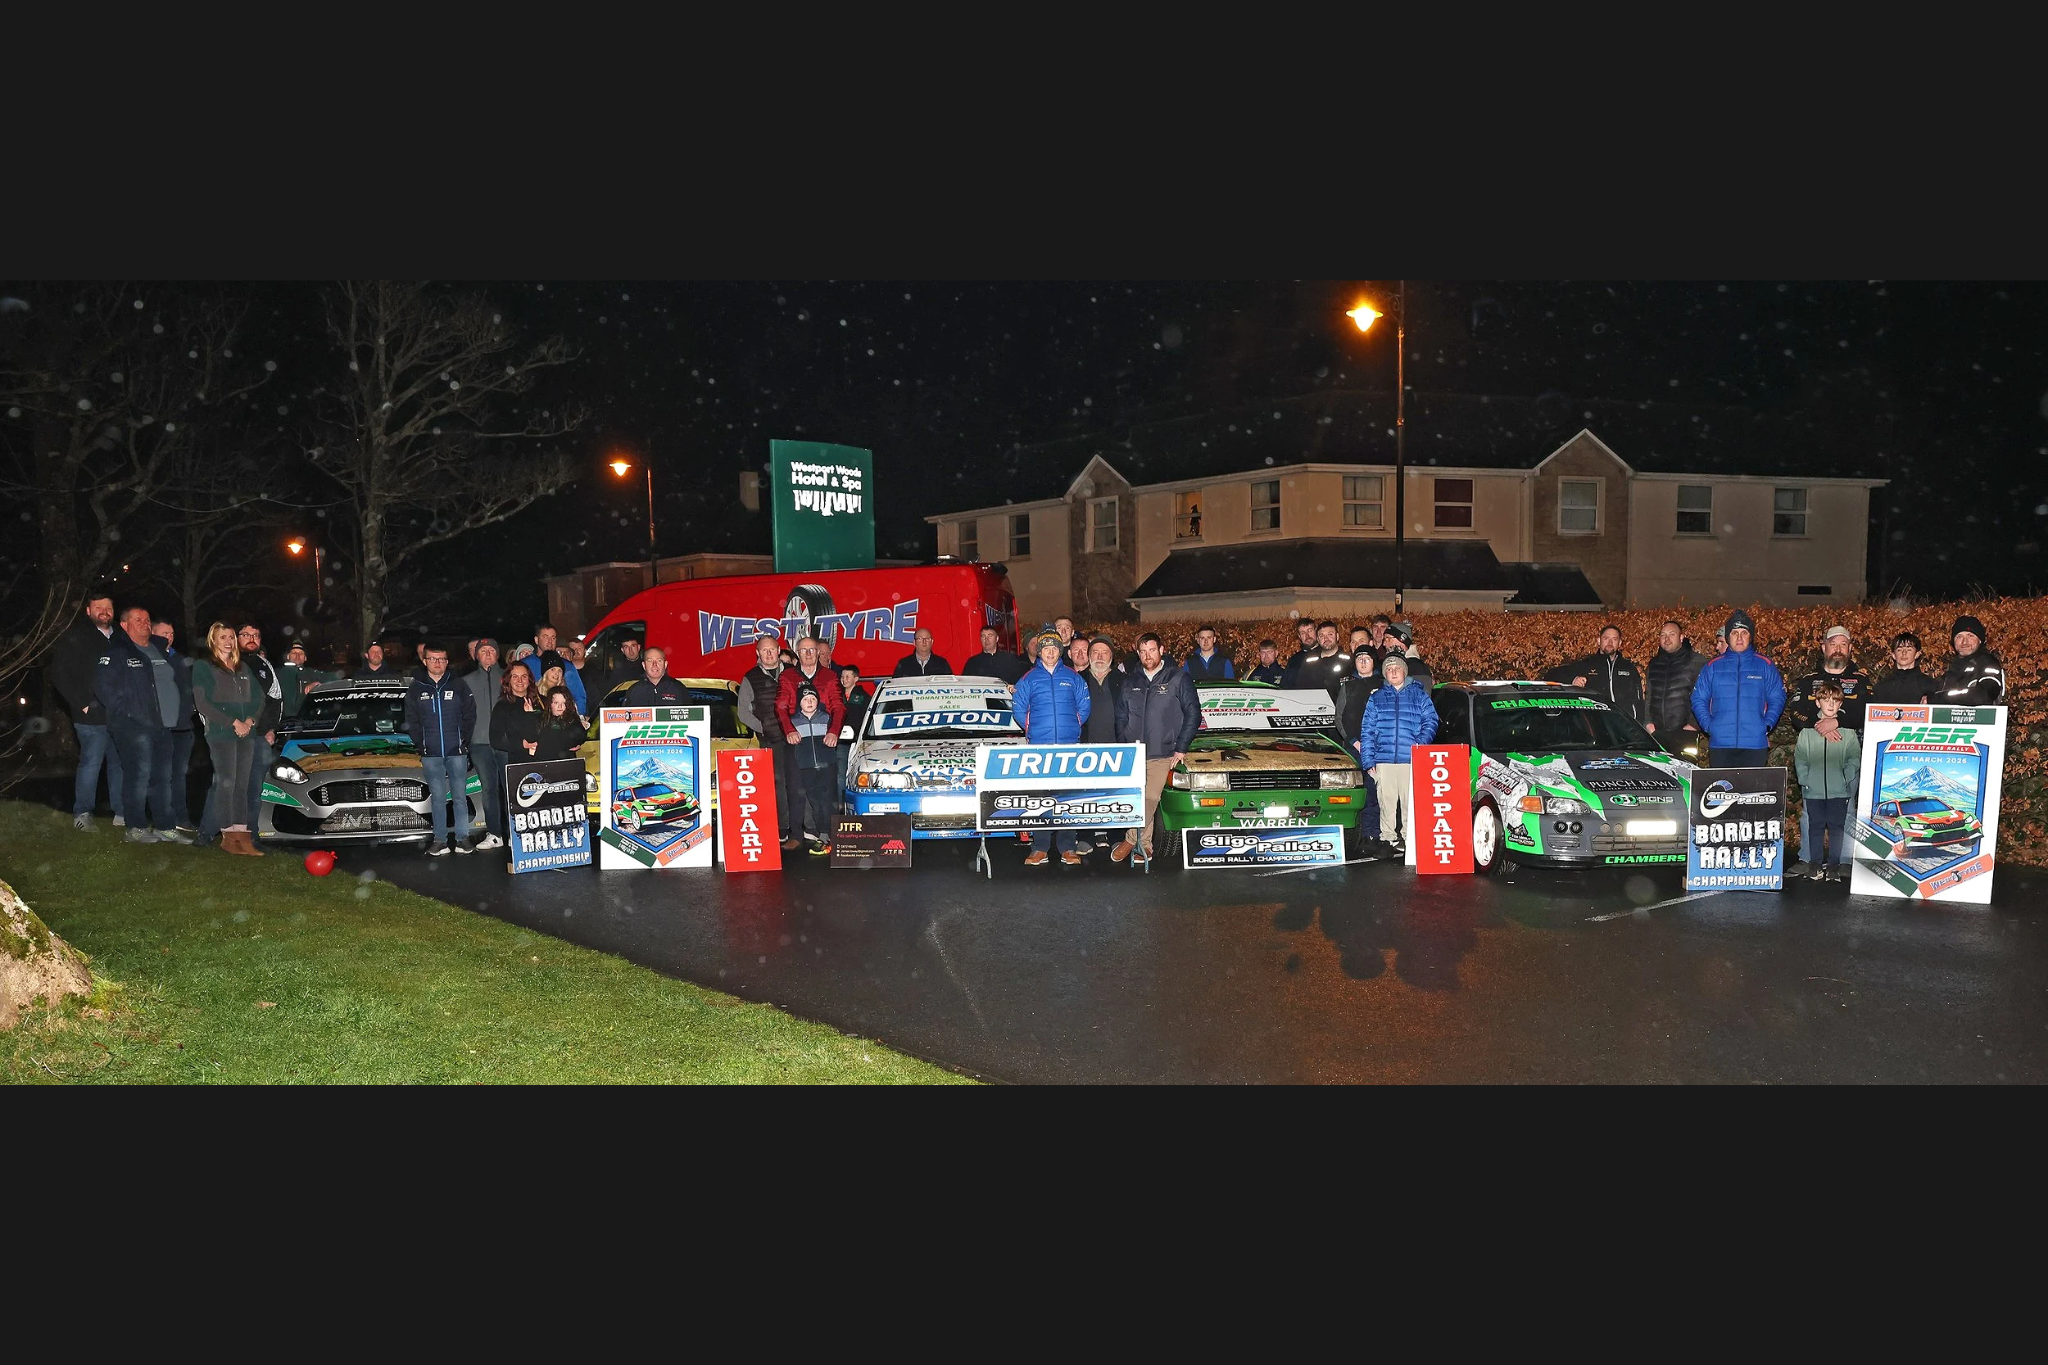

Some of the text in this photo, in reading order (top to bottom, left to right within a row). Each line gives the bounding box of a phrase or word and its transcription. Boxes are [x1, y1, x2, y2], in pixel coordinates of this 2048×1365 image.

[791, 461, 861, 477] Westport Woods
[792, 471, 861, 492] Hotel & Spa
[698, 598, 919, 656] WEST TYRE
[885, 688, 965, 697] RONAN'S
[1491, 698, 1595, 709] CHAMBERS
[893, 712, 1001, 727] TRITON
[624, 725, 689, 739] MSR
[1893, 726, 1978, 744] MSR
[998, 751, 1123, 775] TRITON
[1589, 779, 1637, 789] PUNCH
[1639, 779, 1677, 788] BOWL
[734, 755, 762, 862] TOP PART
[994, 794, 1135, 816] Sligo Pallets
[1429, 751, 1455, 864] TOP PART
[515, 804, 586, 832] BORDER
[986, 818, 1020, 826] BORDER
[1022, 817, 1051, 825] RALLY
[1053, 816, 1111, 824] CHAMPIONSHIP
[1240, 818, 1309, 828] WARREN
[838, 822, 863, 832] JTFR
[1695, 820, 1781, 844] BORDER
[521, 827, 585, 852] RALLY
[1201, 835, 1334, 854] Sligo Pallets
[519, 852, 590, 869] CHAMPIONSHIP
[1605, 855, 1687, 864] CHAMBERS
[1700, 847, 1777, 869] RALLY
[1693, 876, 1780, 887] CHAMPIONSHIP
